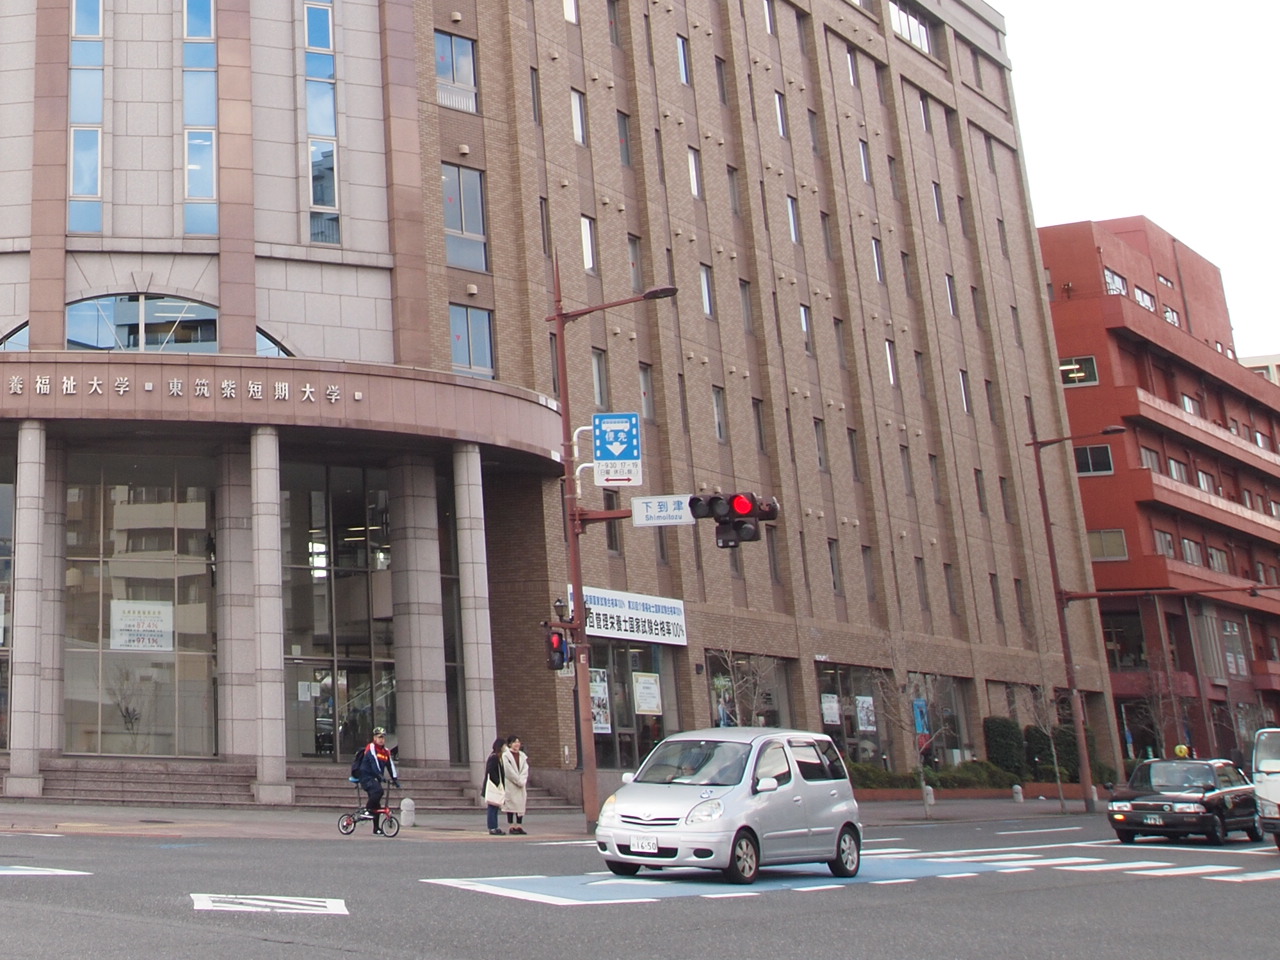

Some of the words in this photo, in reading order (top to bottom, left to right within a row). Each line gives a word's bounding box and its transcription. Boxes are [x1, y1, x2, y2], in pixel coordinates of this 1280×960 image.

[168, 378, 341, 403] 東筑紫短期大学
[605, 431, 628, 442] 優先
[641, 500, 684, 513] 下到津
